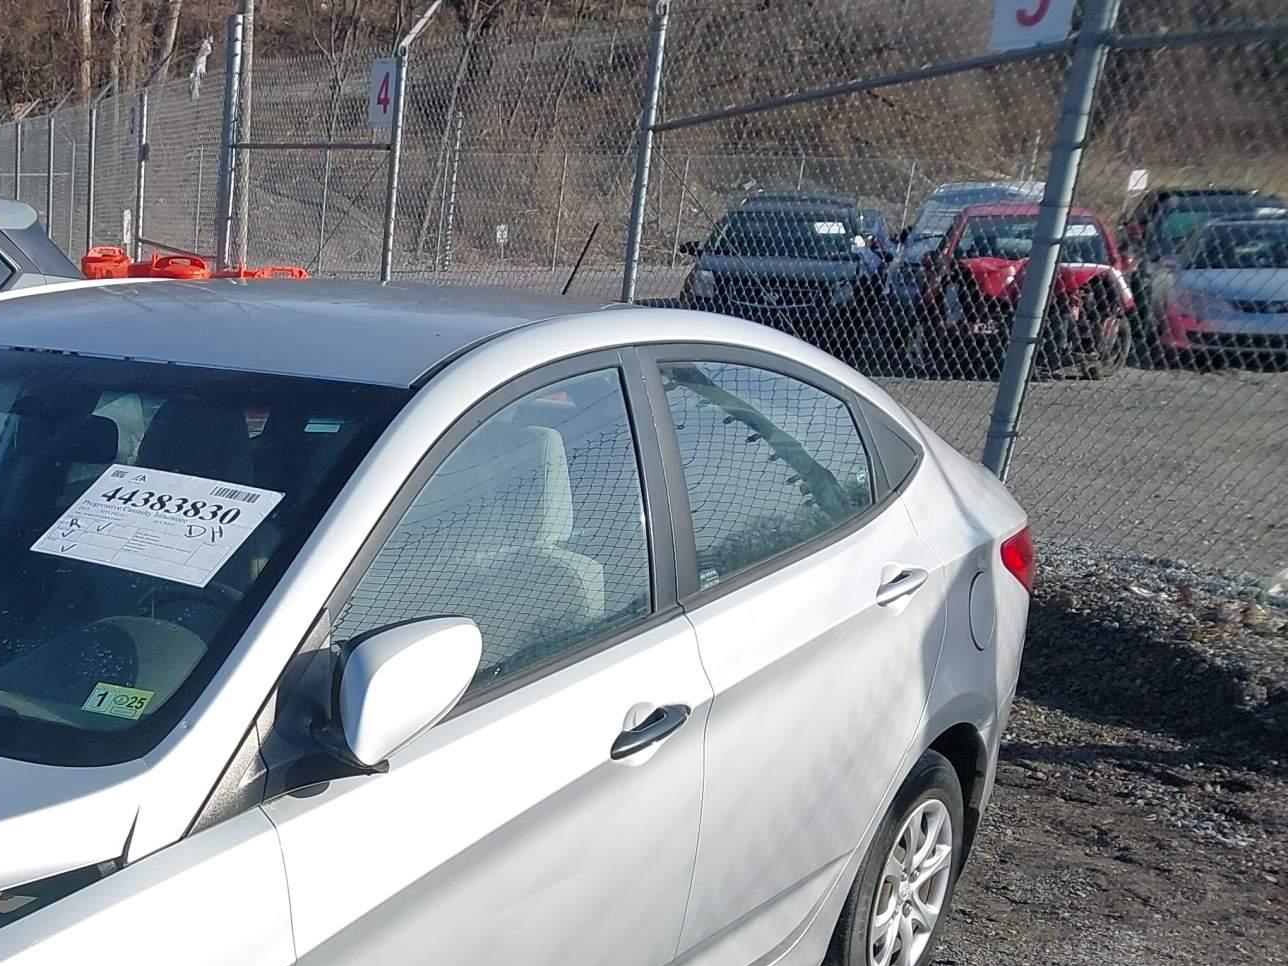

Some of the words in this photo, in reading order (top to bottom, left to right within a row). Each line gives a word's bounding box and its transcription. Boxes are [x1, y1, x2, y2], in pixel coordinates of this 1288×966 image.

[377, 72, 390, 114] 4
[102, 486, 241, 525] 44383830
[97, 691, 108, 707] 1
[126, 695, 147, 709] 25
